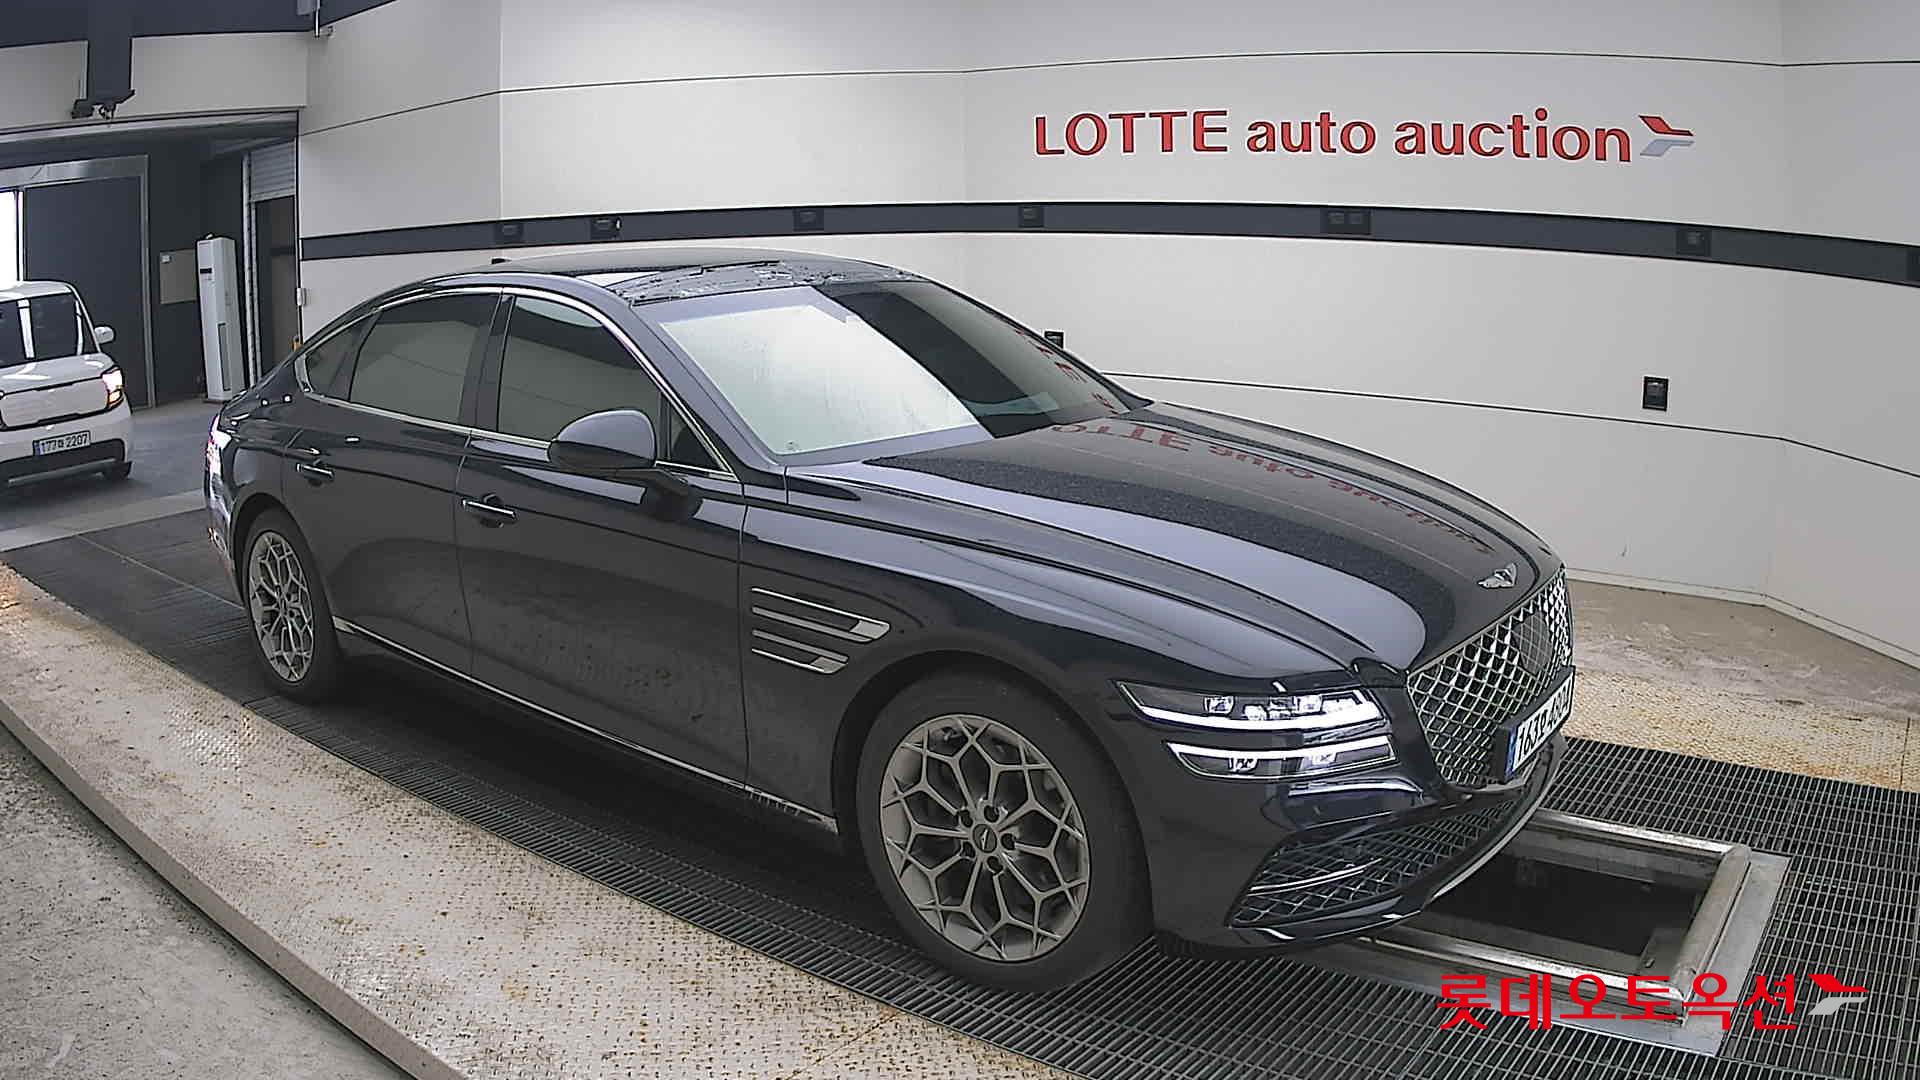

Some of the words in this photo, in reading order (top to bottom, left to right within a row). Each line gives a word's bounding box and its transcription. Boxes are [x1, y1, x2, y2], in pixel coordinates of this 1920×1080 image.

[1034, 110, 1228, 157] LOTTE
[1246, 111, 1377, 154] auto
[1394, 106, 1632, 163] auction
